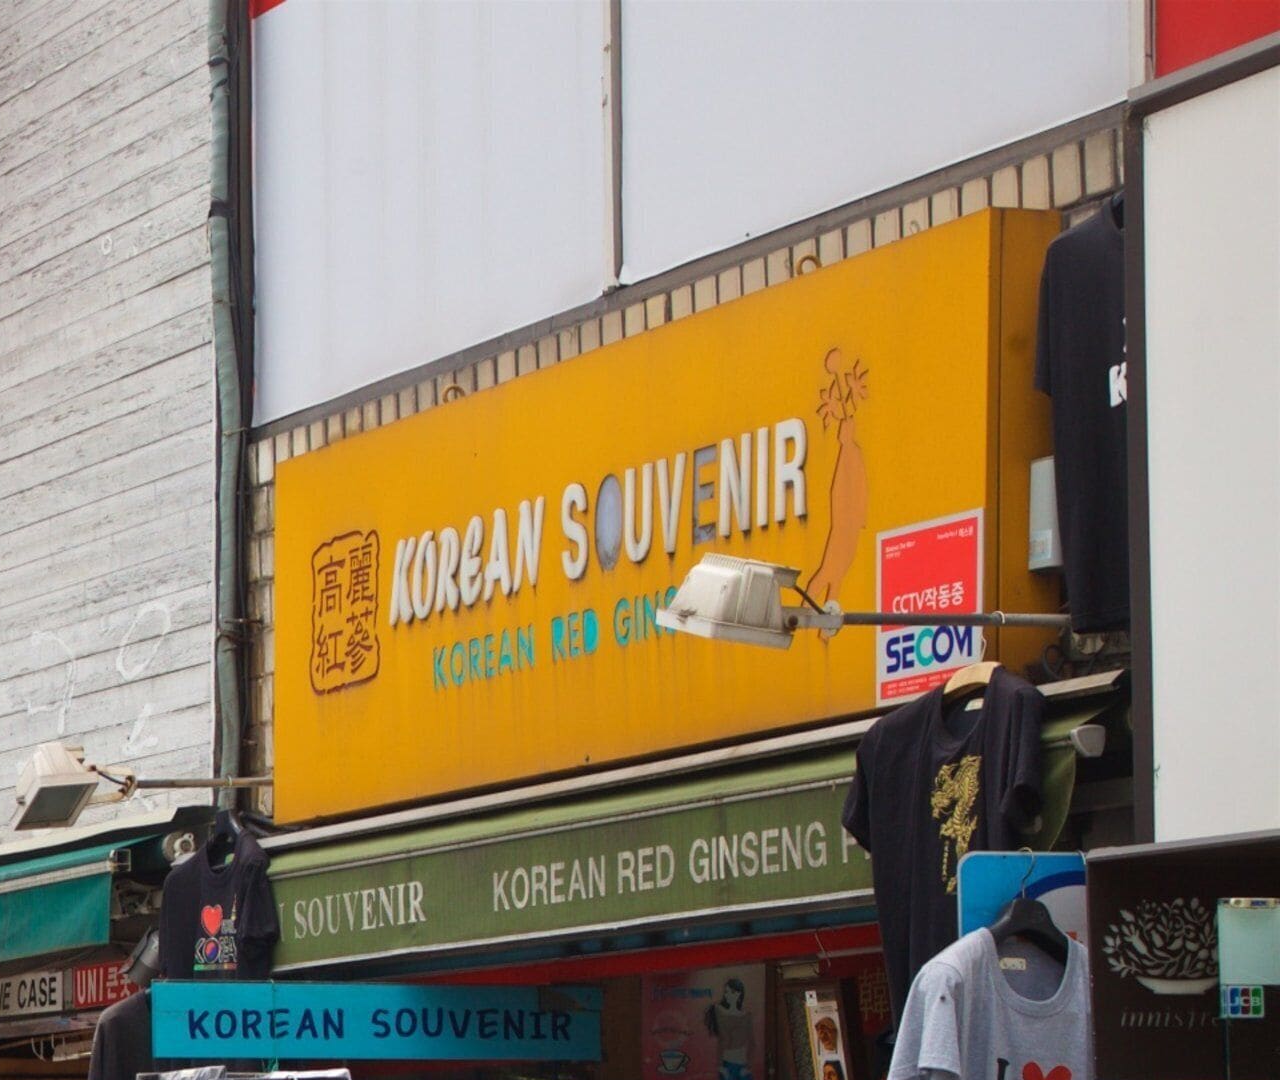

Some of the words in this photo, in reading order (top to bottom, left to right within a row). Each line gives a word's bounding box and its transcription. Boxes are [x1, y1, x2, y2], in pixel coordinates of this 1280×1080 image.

[390, 496, 545, 627] KOREAN
[561, 418, 808, 580] SOUVENIR
[893, 582, 965, 616] CCTV작동중
[433, 626, 535, 689] KOREAN
[551, 607, 599, 662] RED
[886, 623, 973, 673] SECOM
[492, 855, 607, 912] KOREAN
[617, 844, 675, 895] RED
[689, 821, 828, 885] GINSENG
[294, 881, 427, 939] SOUVENIR
[17, 974, 57, 1008] CASE
[188, 1008, 345, 1041] KOREAN
[372, 1007, 571, 1040] SOUVENIR
